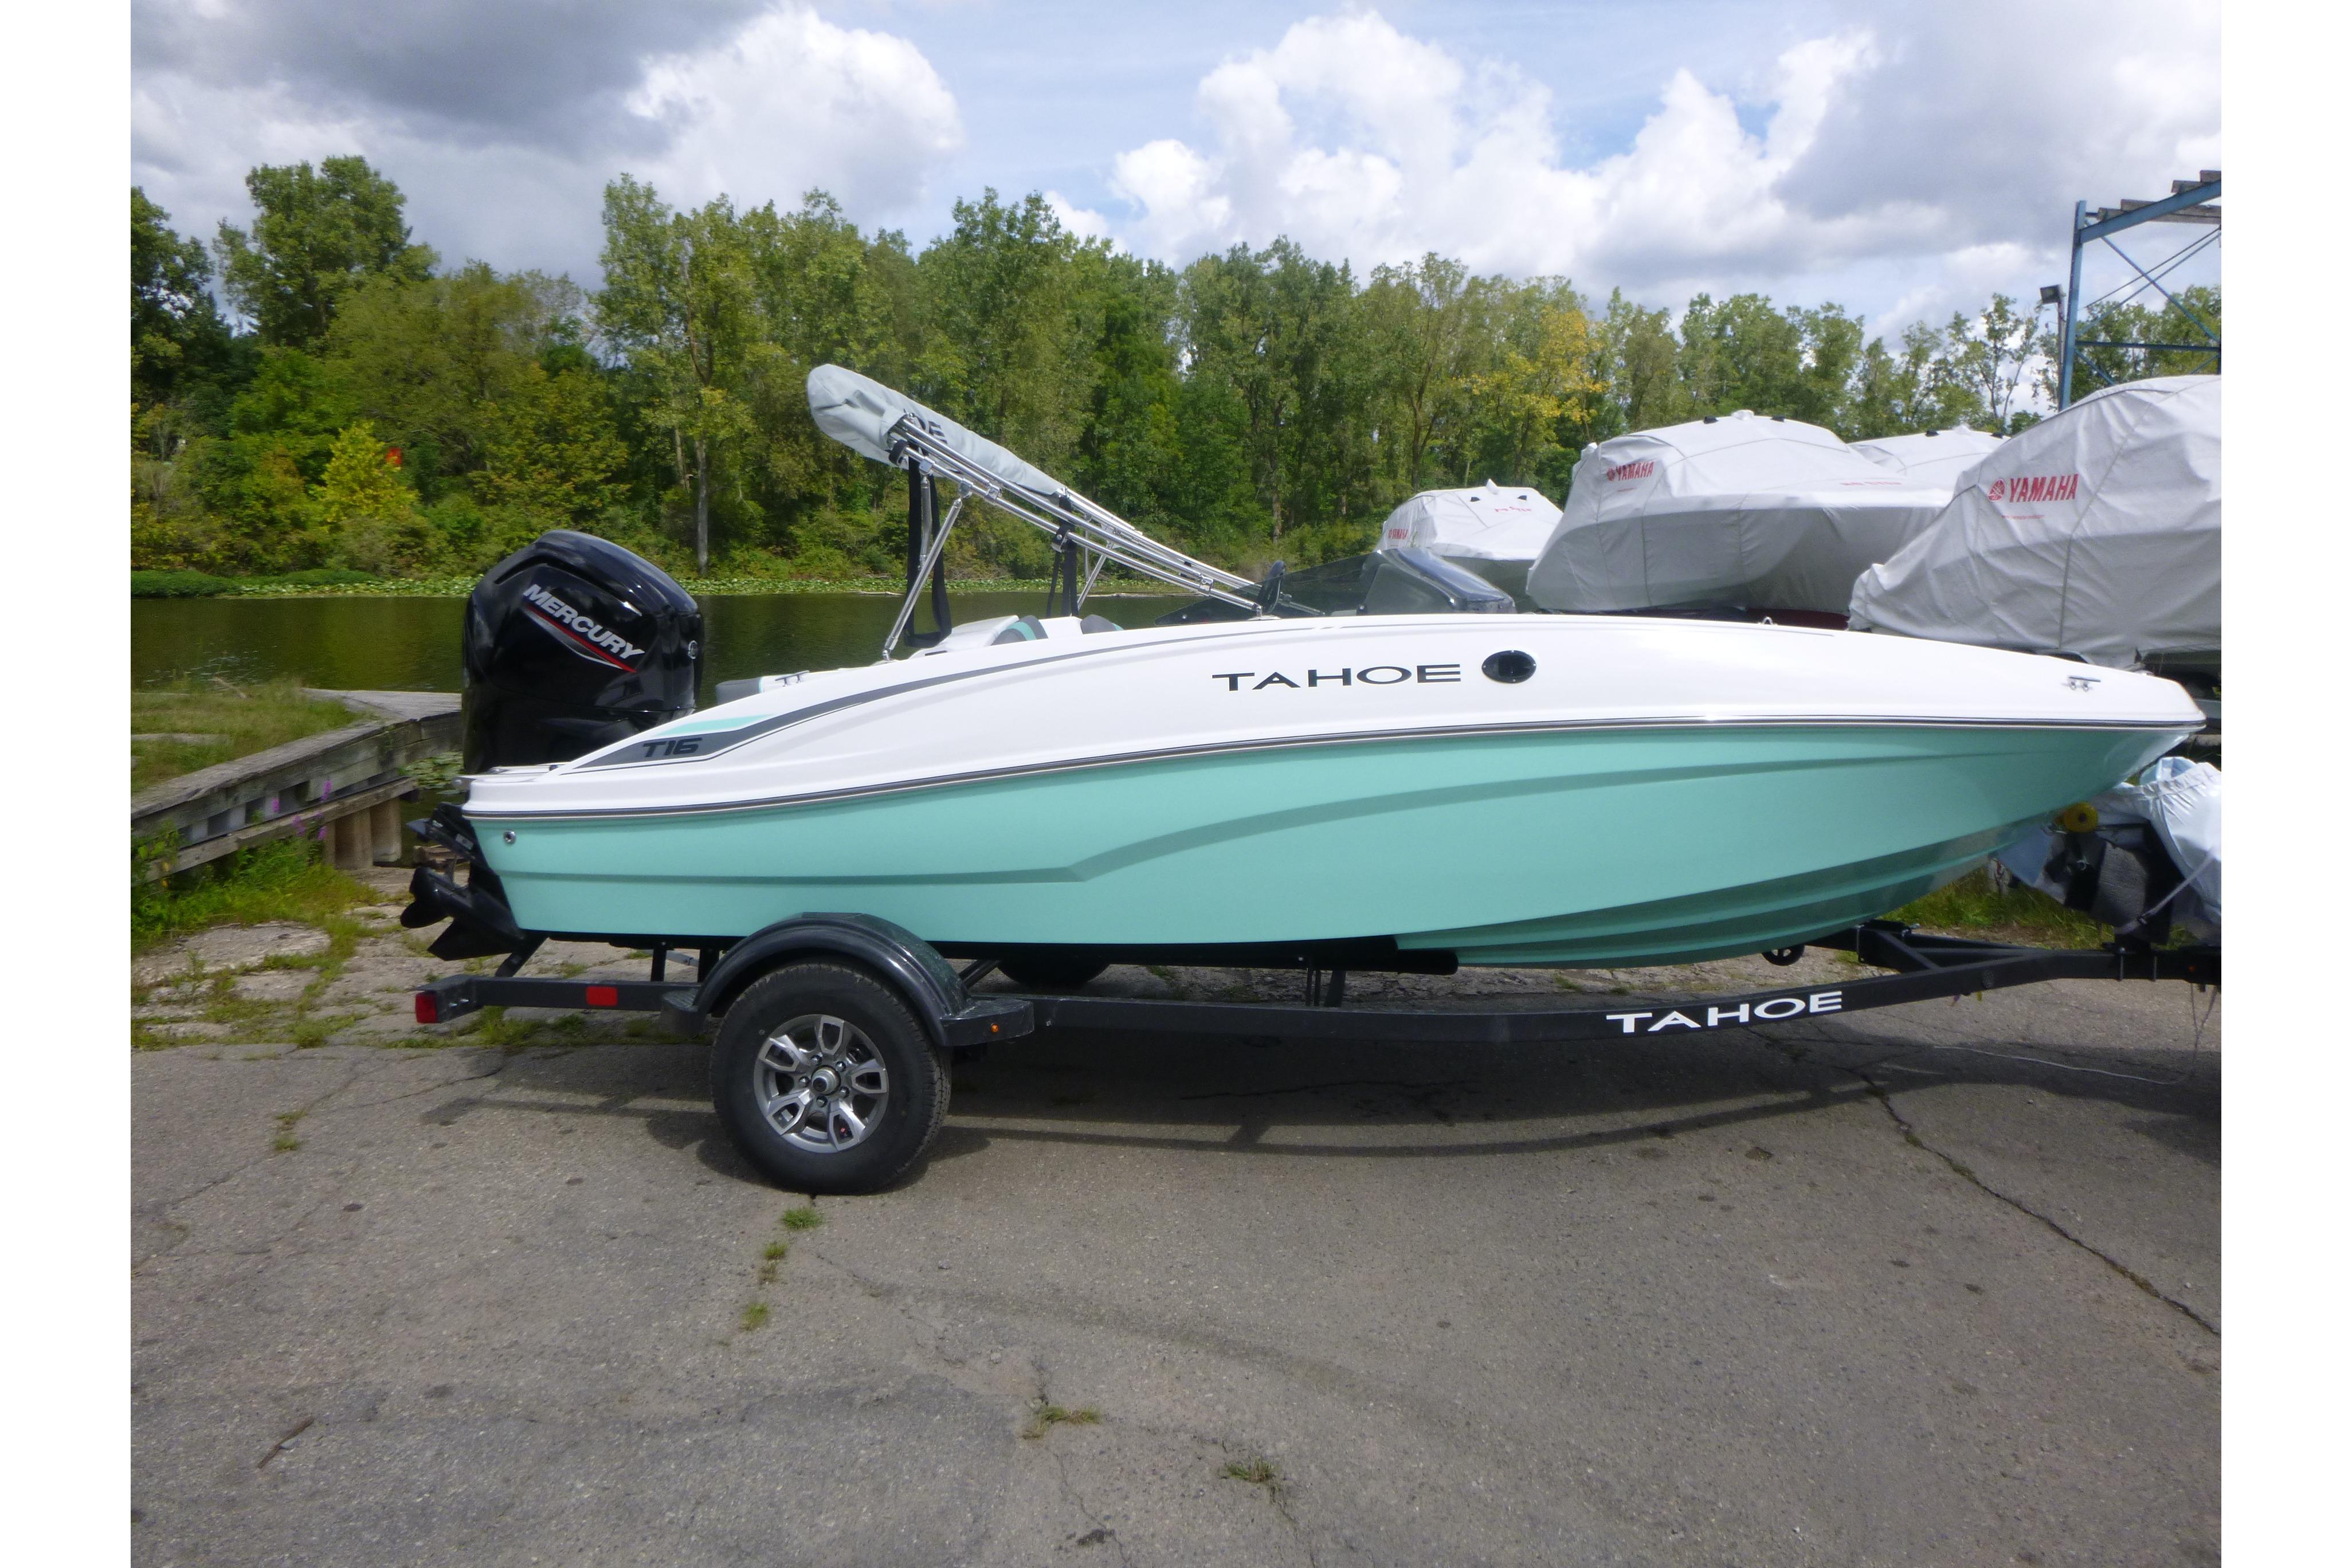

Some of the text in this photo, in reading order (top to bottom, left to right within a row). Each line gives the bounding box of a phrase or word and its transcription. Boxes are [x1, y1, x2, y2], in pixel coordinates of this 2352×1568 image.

[1616, 461, 1654, 481] YAMAHA
[2009, 473, 2079, 503] YAMAHA
[523, 583, 645, 659] MERCURY
[1212, 664, 1461, 691] TAHOE
[643, 738, 702, 758] T16
[1606, 991, 1843, 1033] TAHOE
